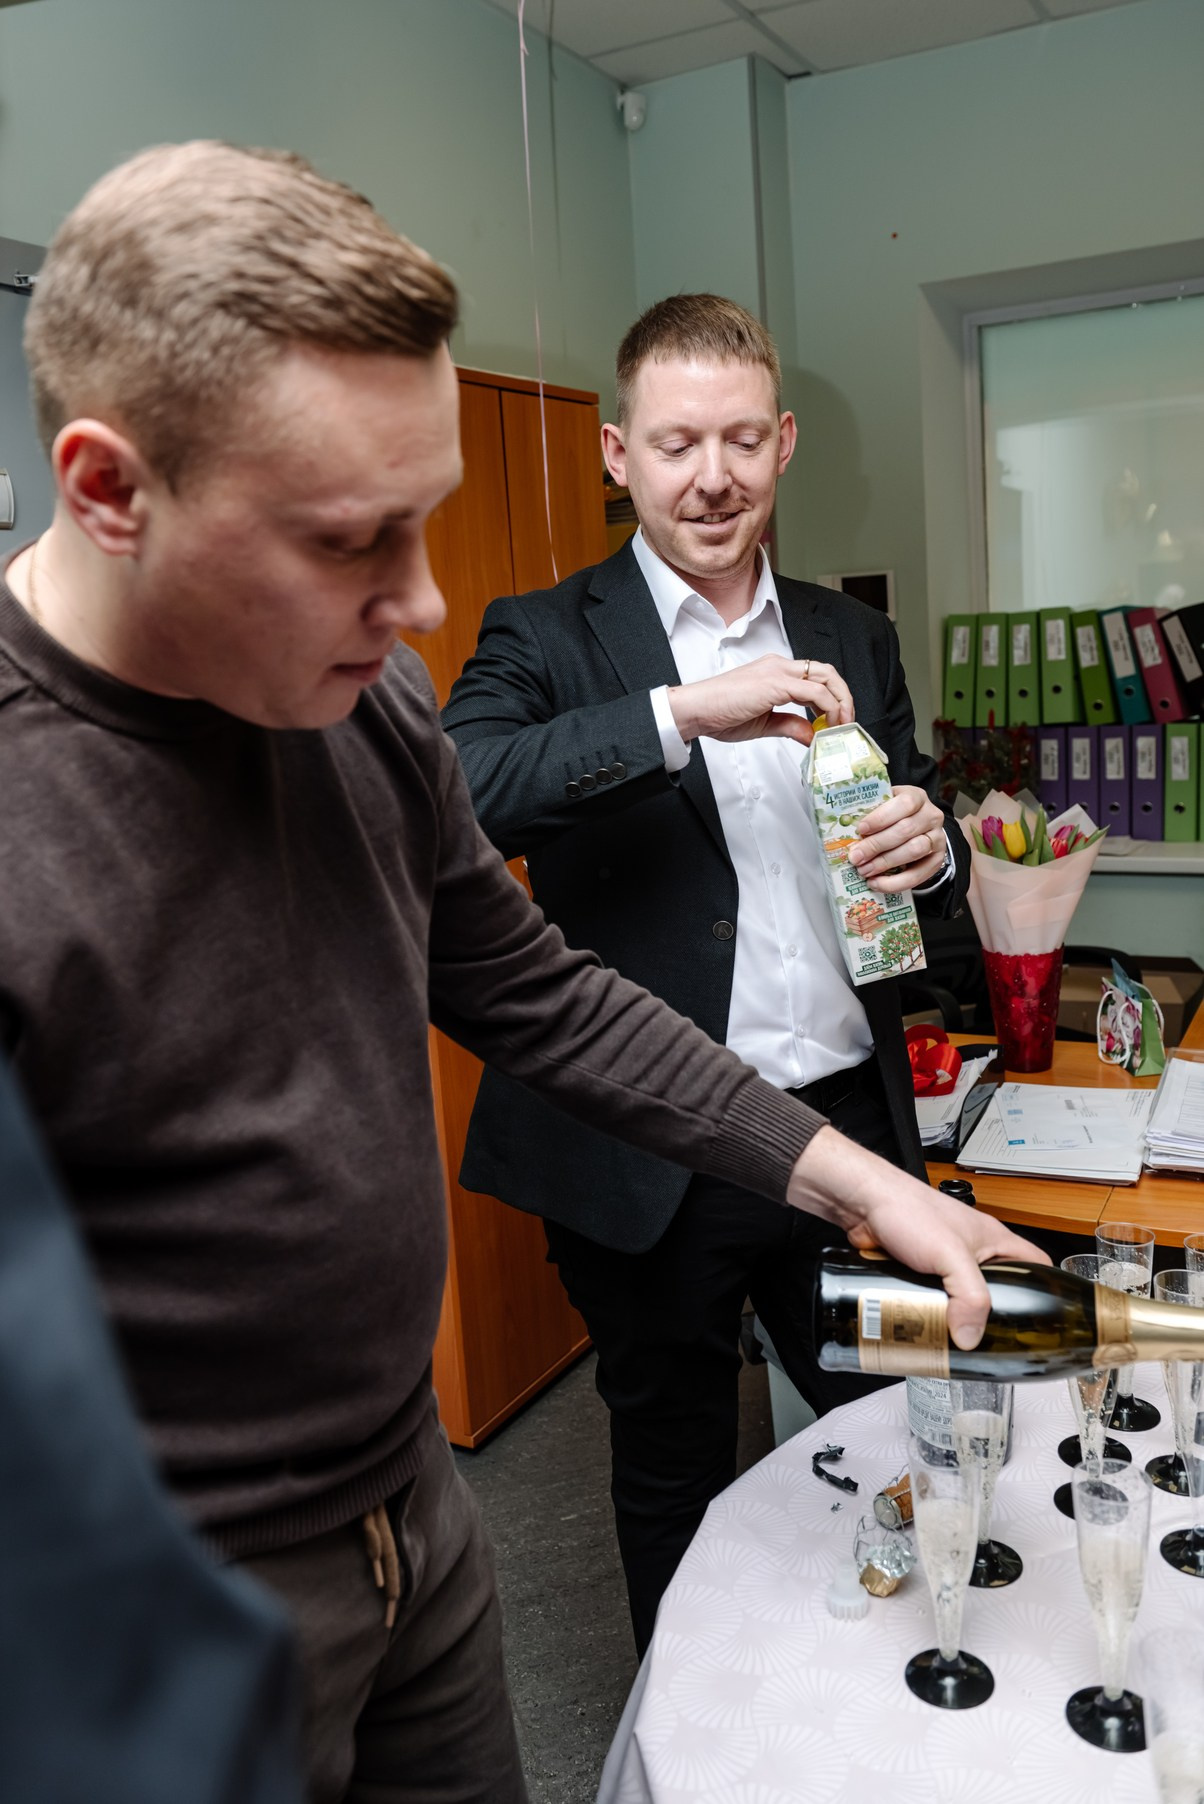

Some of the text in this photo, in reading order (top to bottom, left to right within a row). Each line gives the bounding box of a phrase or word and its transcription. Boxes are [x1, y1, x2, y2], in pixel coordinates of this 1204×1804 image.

[826, 793, 834, 808] 4
[834, 789, 856, 799] ИСТОРИИ
[862, 783, 879, 791] ЖИЗНИ
[843, 795, 861, 804] НАШИХ
[862, 790, 879, 799] САДАХ
